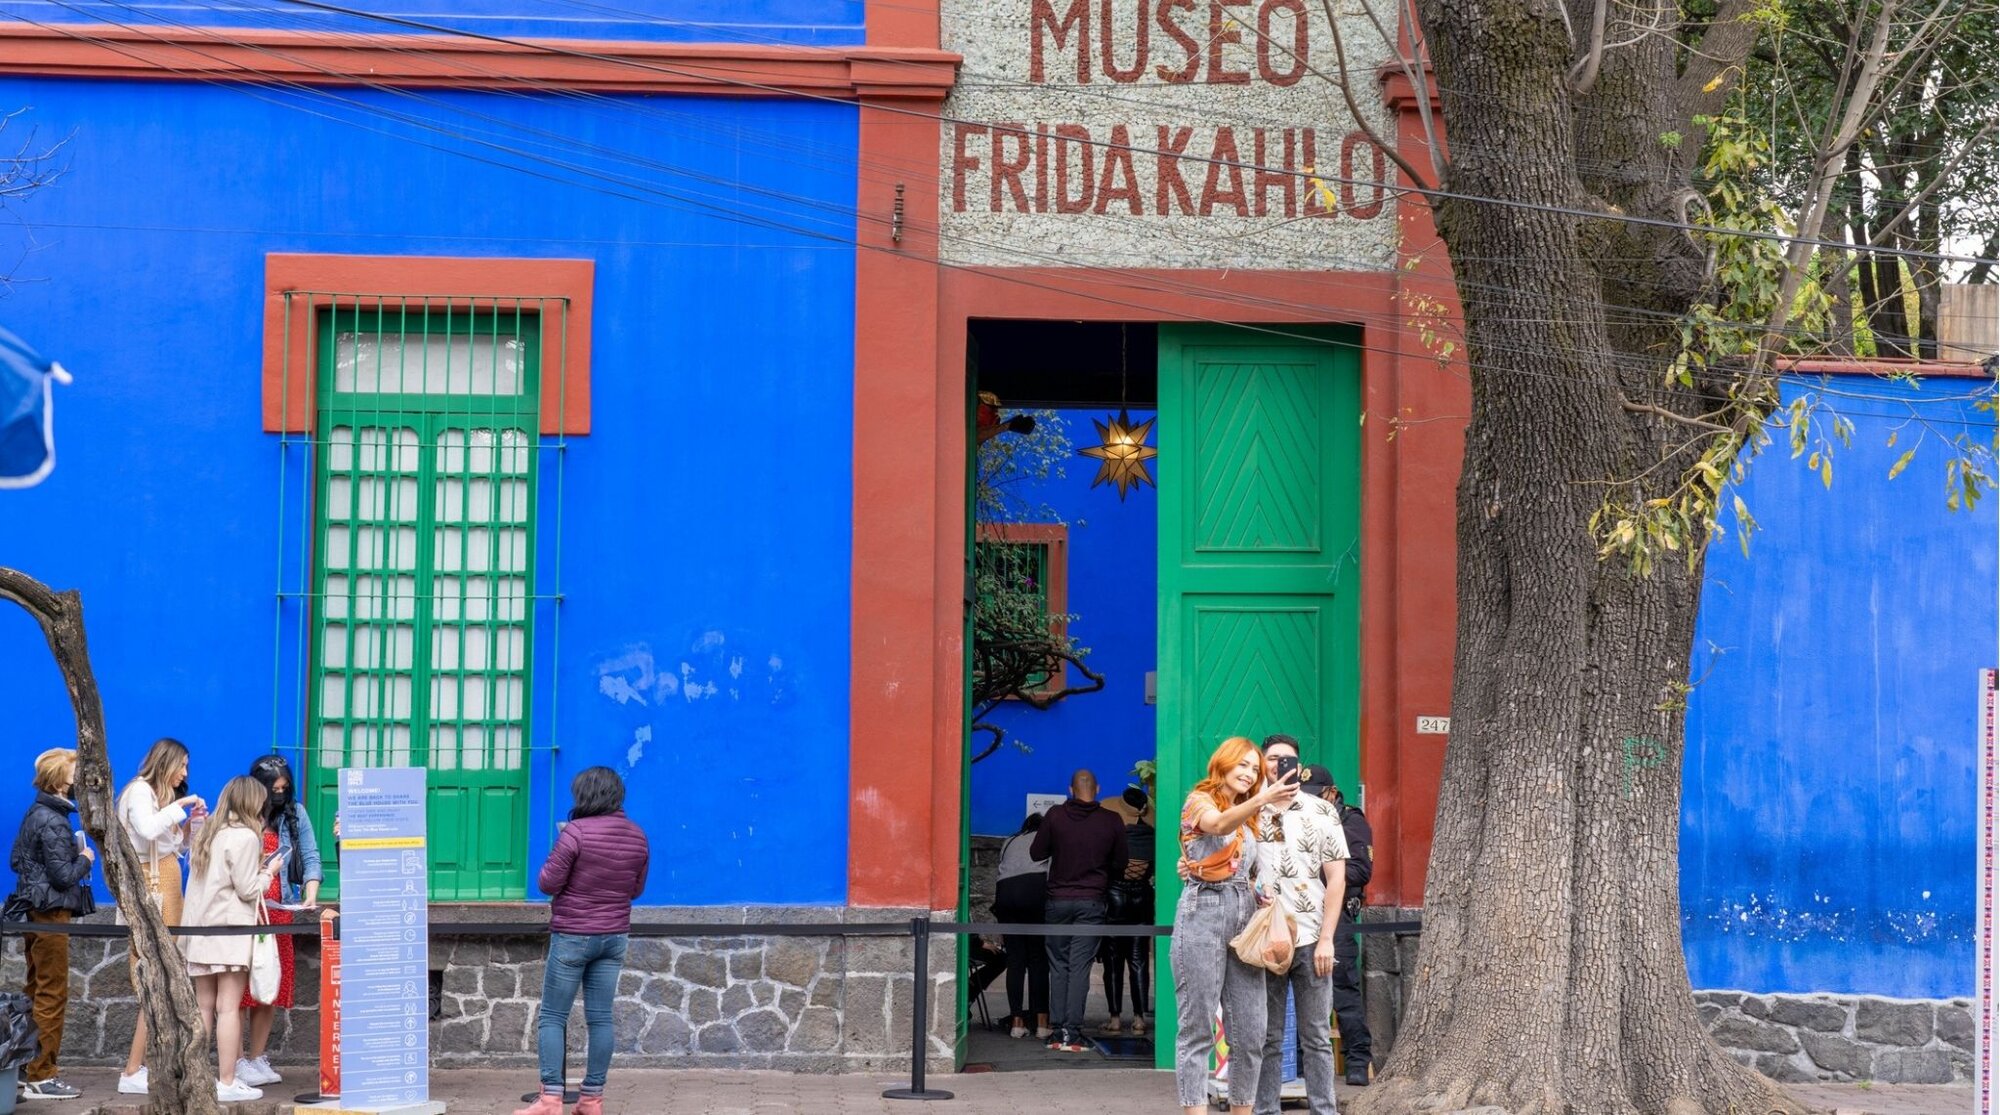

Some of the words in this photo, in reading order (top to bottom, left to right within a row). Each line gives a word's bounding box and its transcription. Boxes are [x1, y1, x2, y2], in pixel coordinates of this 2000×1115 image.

[1029, 0, 1309, 87] MUSEO
[952, 121, 1143, 215] FRIDA
[1155, 124, 1385, 220] KAHLO
[1421, 719, 1449, 731] 247
[1623, 737, 1667, 800] P
[331, 988, 341, 1076] INTERNET
